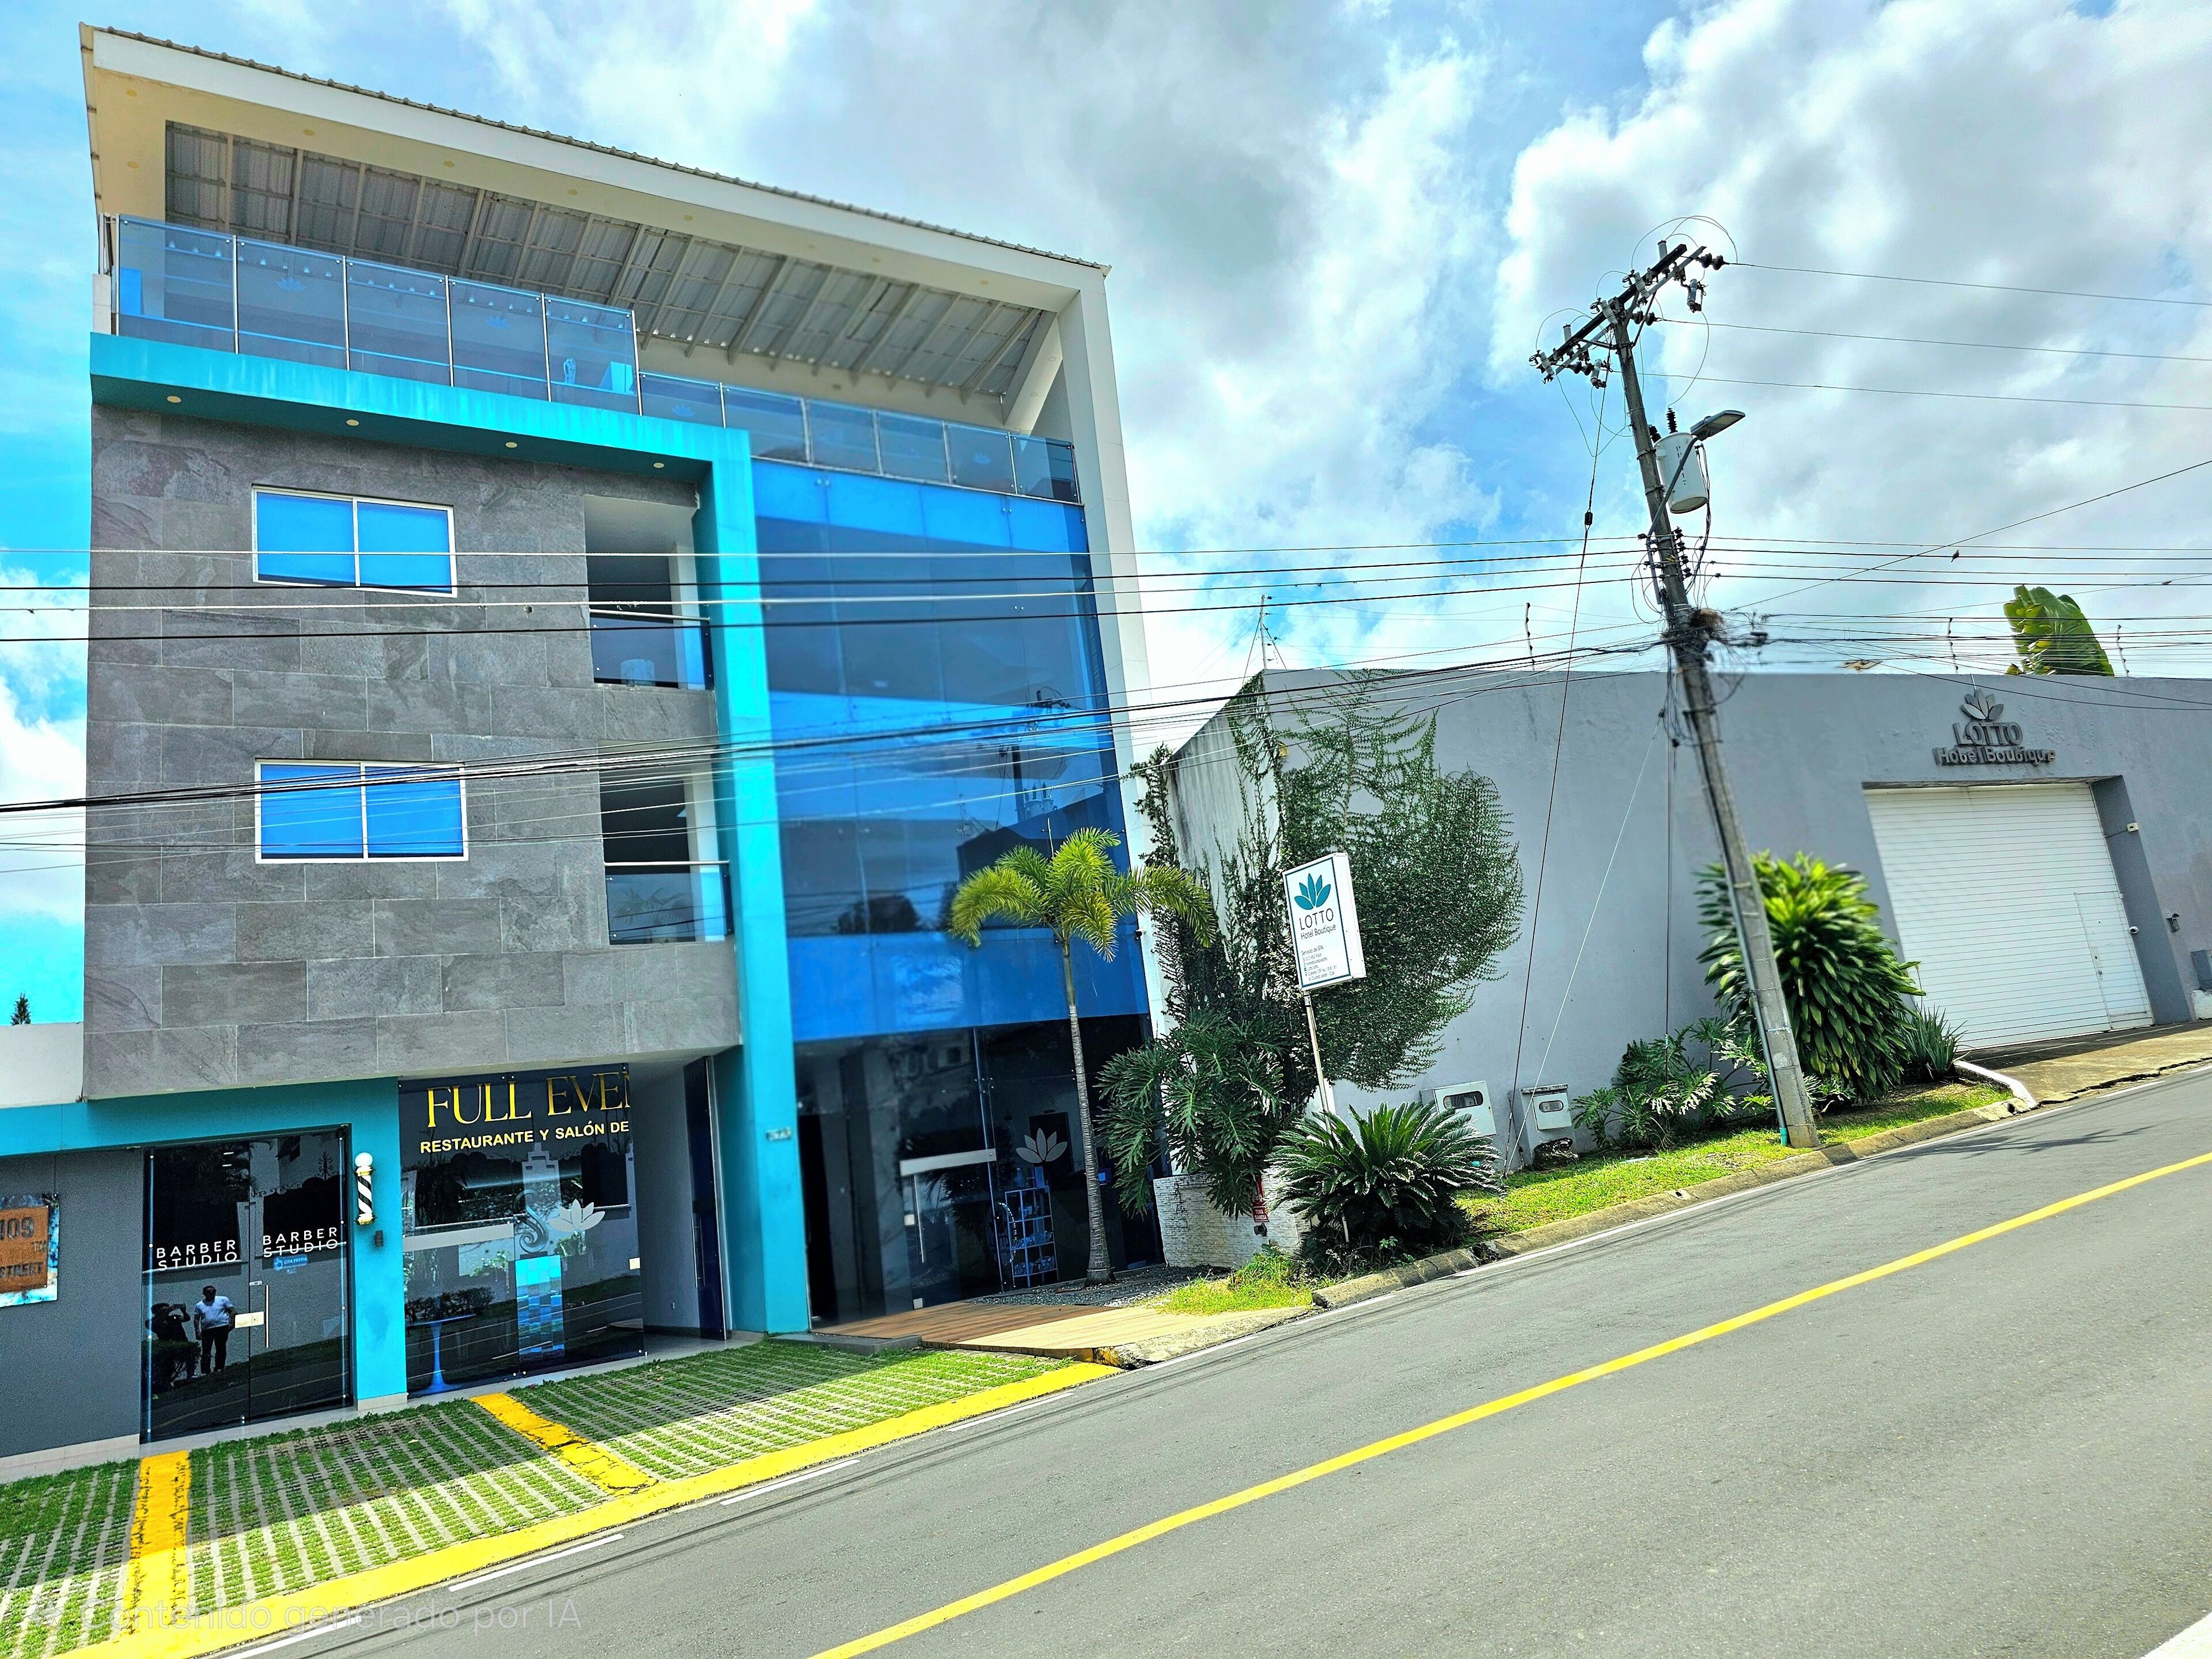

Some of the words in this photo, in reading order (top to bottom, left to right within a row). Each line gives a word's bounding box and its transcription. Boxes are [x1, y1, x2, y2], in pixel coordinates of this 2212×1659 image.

[1952, 722, 2023, 745] LOTTO
[1934, 746, 1984, 765] Hotel
[1987, 747, 2055, 766] Boutique
[1299, 908, 1334, 930] LOTTO
[1300, 929, 1314, 940] Hotel
[1314, 924, 1336, 936] Boutique
[427, 1080, 532, 1127] FULL
[421, 1130, 534, 1153] RESTAURANTE
[539, 1129, 550, 1141] Y
[555, 1120, 605, 1139] SALÓN
[611, 1121, 630, 1133] DE
[263, 1227, 338, 1246] BARBER
[156, 1239, 236, 1259] BARBER
[263, 1238, 339, 1258] STUDIO
[158, 1251, 237, 1271] STUDIO
